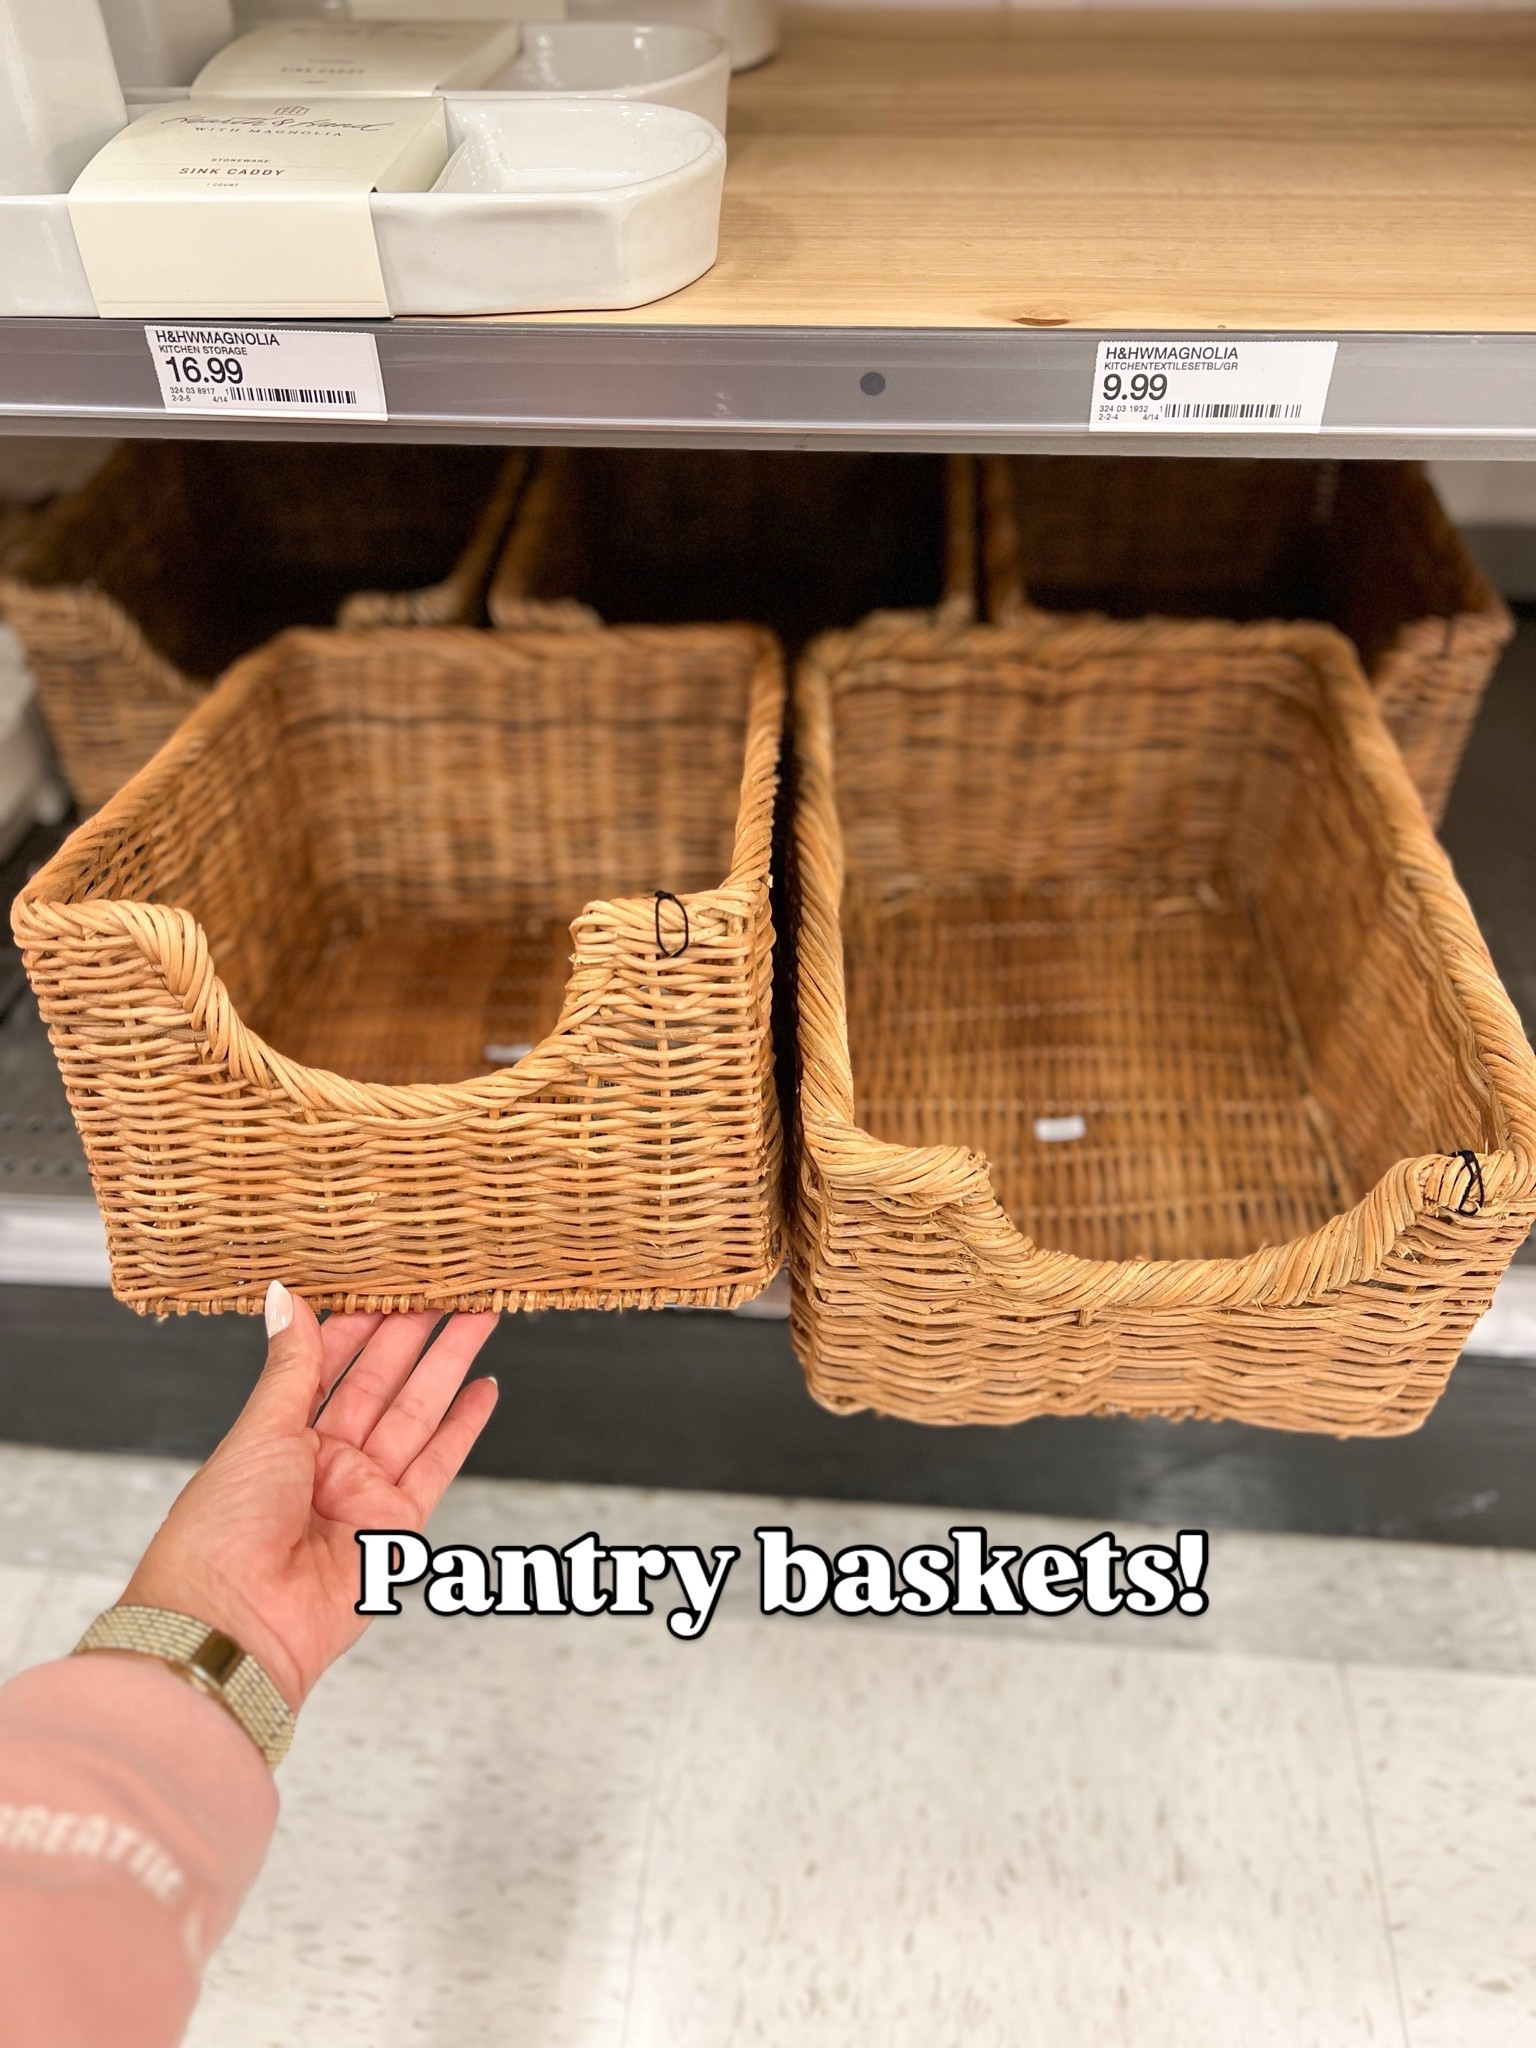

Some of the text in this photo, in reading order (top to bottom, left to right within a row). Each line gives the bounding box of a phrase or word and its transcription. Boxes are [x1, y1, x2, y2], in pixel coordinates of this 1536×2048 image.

[248, 129, 343, 137] MAGNOLIA
[179, 167, 286, 176] SINK CADDY
[155, 330, 281, 346] H&HWMAGNOLIA
[159, 345, 248, 356] KITCHEN STORAGE
[1105, 347, 1239, 360] H&HWMAGNOLIA
[165, 356, 244, 384] 16.99
[1104, 362, 1239, 371] KITCHENTEXTILESETBL/GR
[197, 387, 215, 395] 8917
[1102, 373, 1168, 400] 9.99
[212, 395, 228, 403] 4/14
[1142, 413, 1159, 421] 4/14
